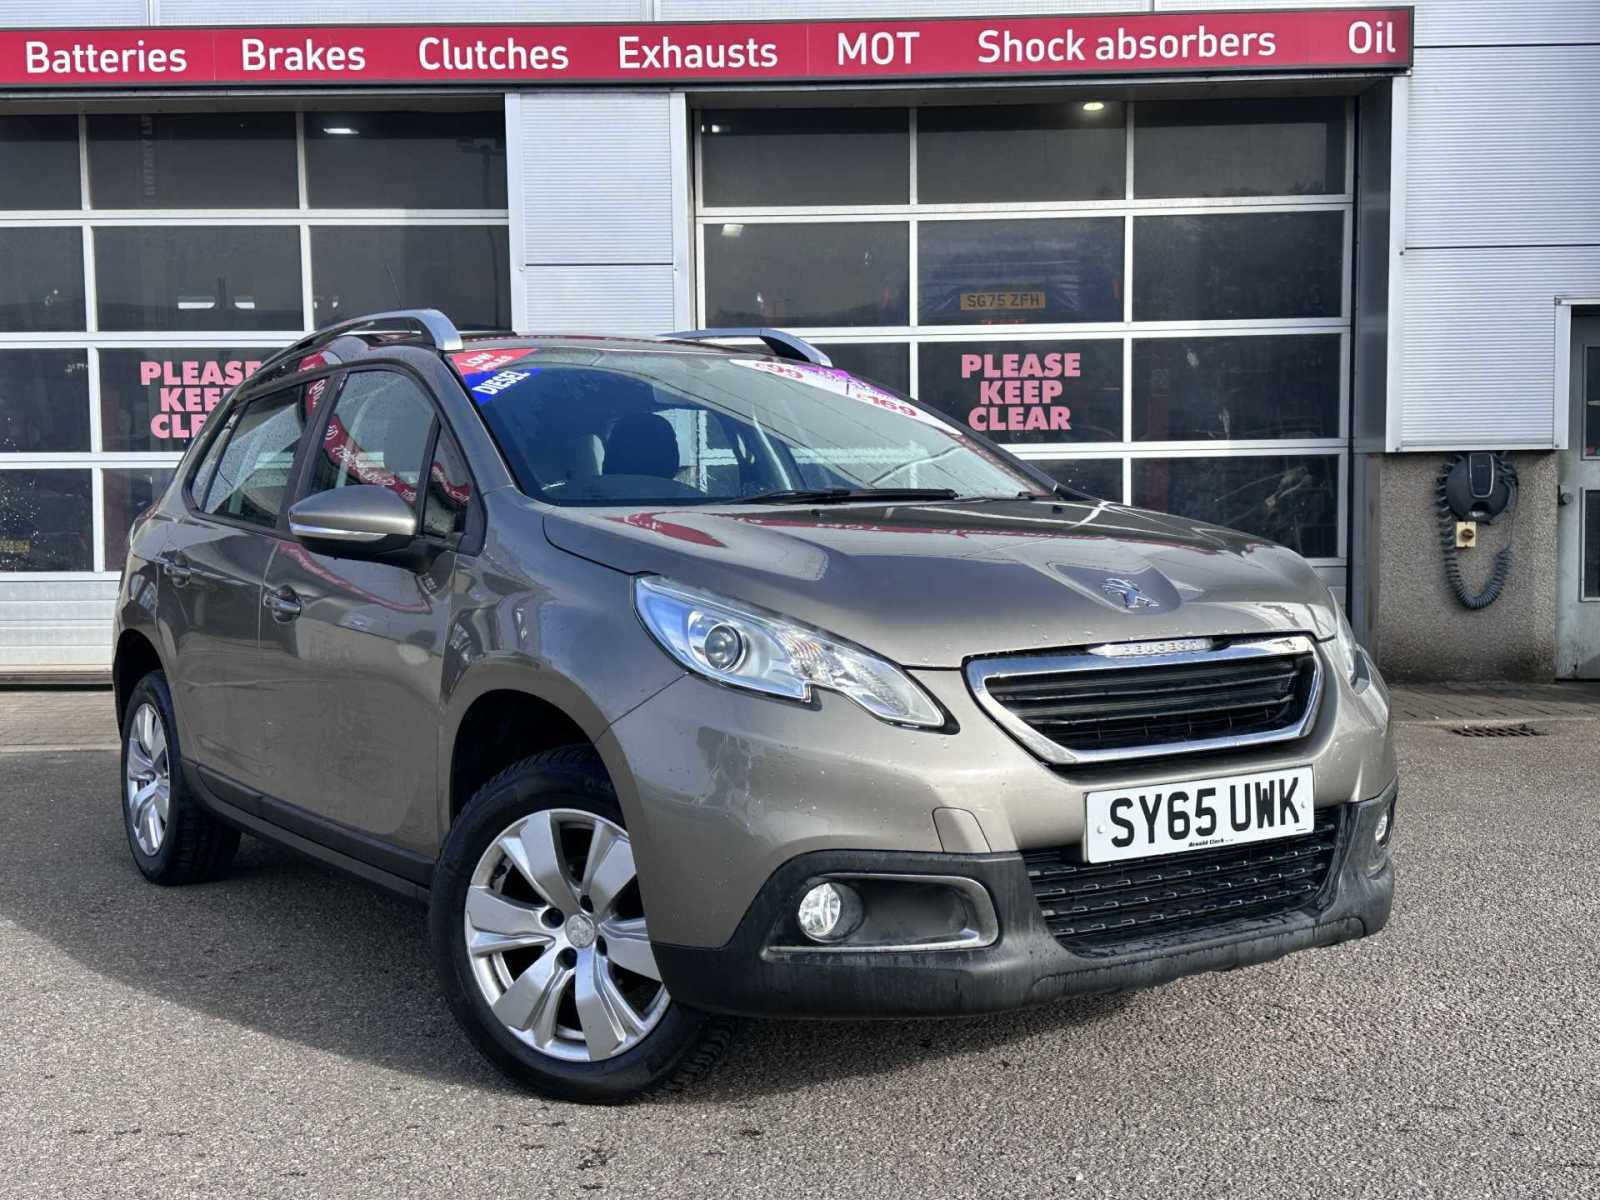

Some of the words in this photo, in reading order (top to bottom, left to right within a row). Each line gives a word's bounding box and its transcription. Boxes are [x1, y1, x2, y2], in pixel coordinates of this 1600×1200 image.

[25, 40, 188, 74] Batteries
[241, 38, 366, 71] Brakes
[418, 37, 569, 71] Clutches
[619, 36, 778, 69] Exhausts
[837, 31, 921, 66] MOT
[977, 28, 1086, 64] Shock
[1095, 25, 1277, 61] absorbers
[1348, 20, 1397, 55] Oil
[967, 293, 1006, 307] SG75
[1010, 292, 1040, 307] ZFH
[961, 352, 1081, 378] PLEASE
[471, 370, 531, 395] DIESEL
[980, 380, 1063, 405] KEEP
[160, 387, 233, 412] KEE
[968, 406, 1072, 431] CLEAR
[1109, 787, 1217, 848] SY65
[1229, 776, 1300, 833] UWK
